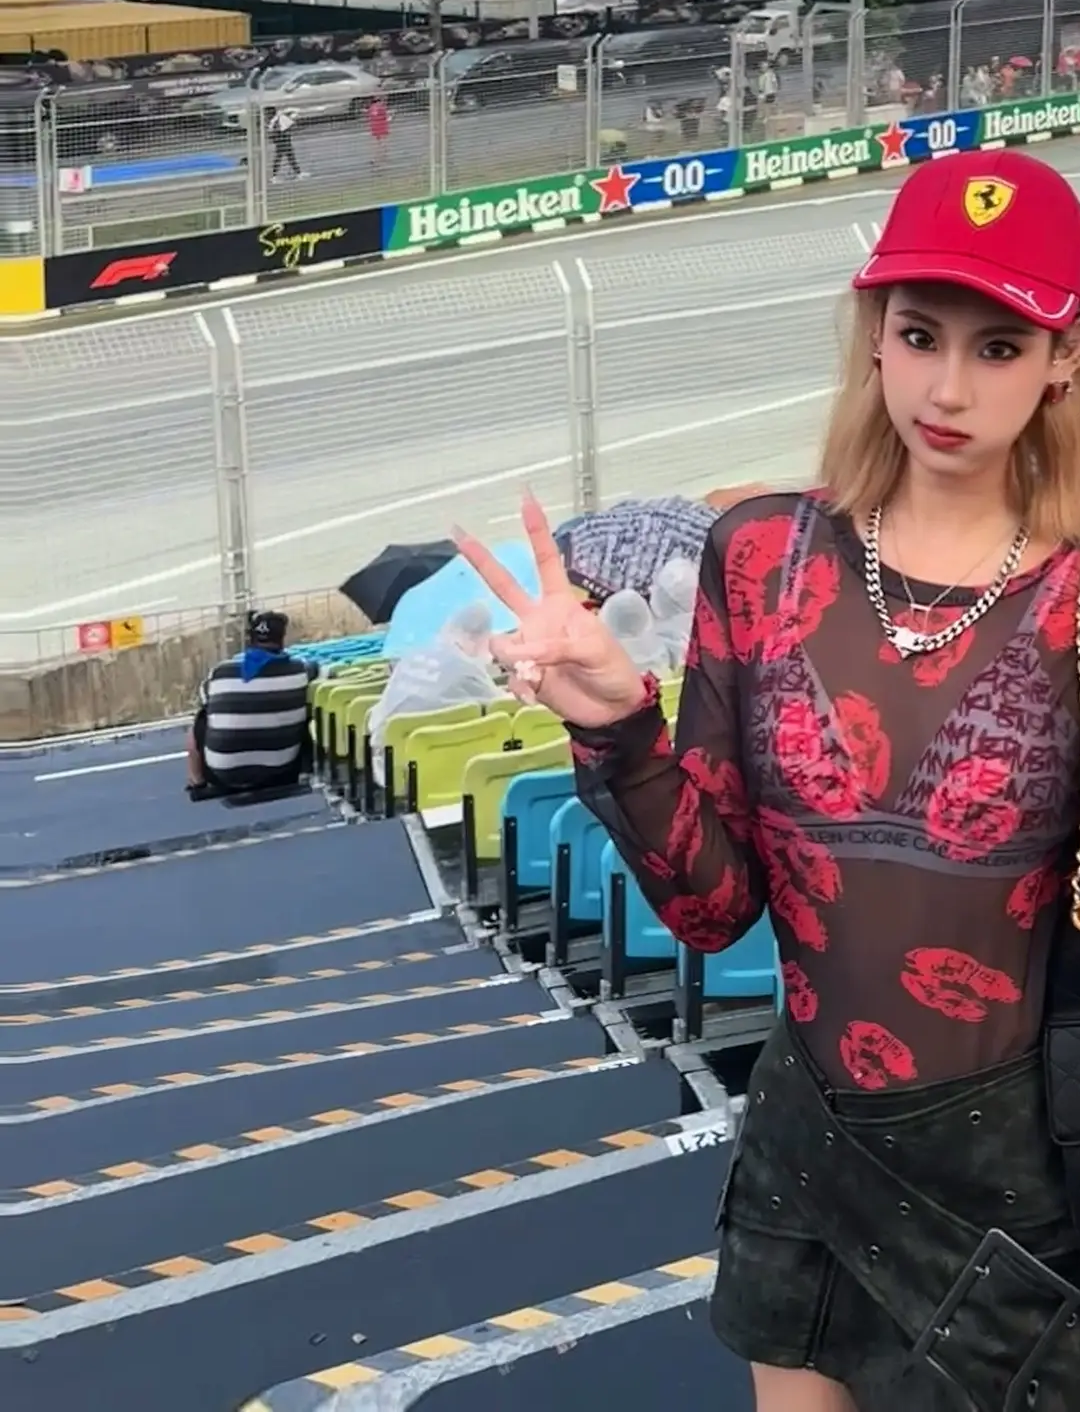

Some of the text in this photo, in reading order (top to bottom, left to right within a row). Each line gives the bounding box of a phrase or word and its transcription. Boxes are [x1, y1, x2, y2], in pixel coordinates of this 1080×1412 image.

[745, 139, 870, 182] Heineken
[408, 186, 581, 241] Heineken
[258, 223, 347, 267] Singapore
